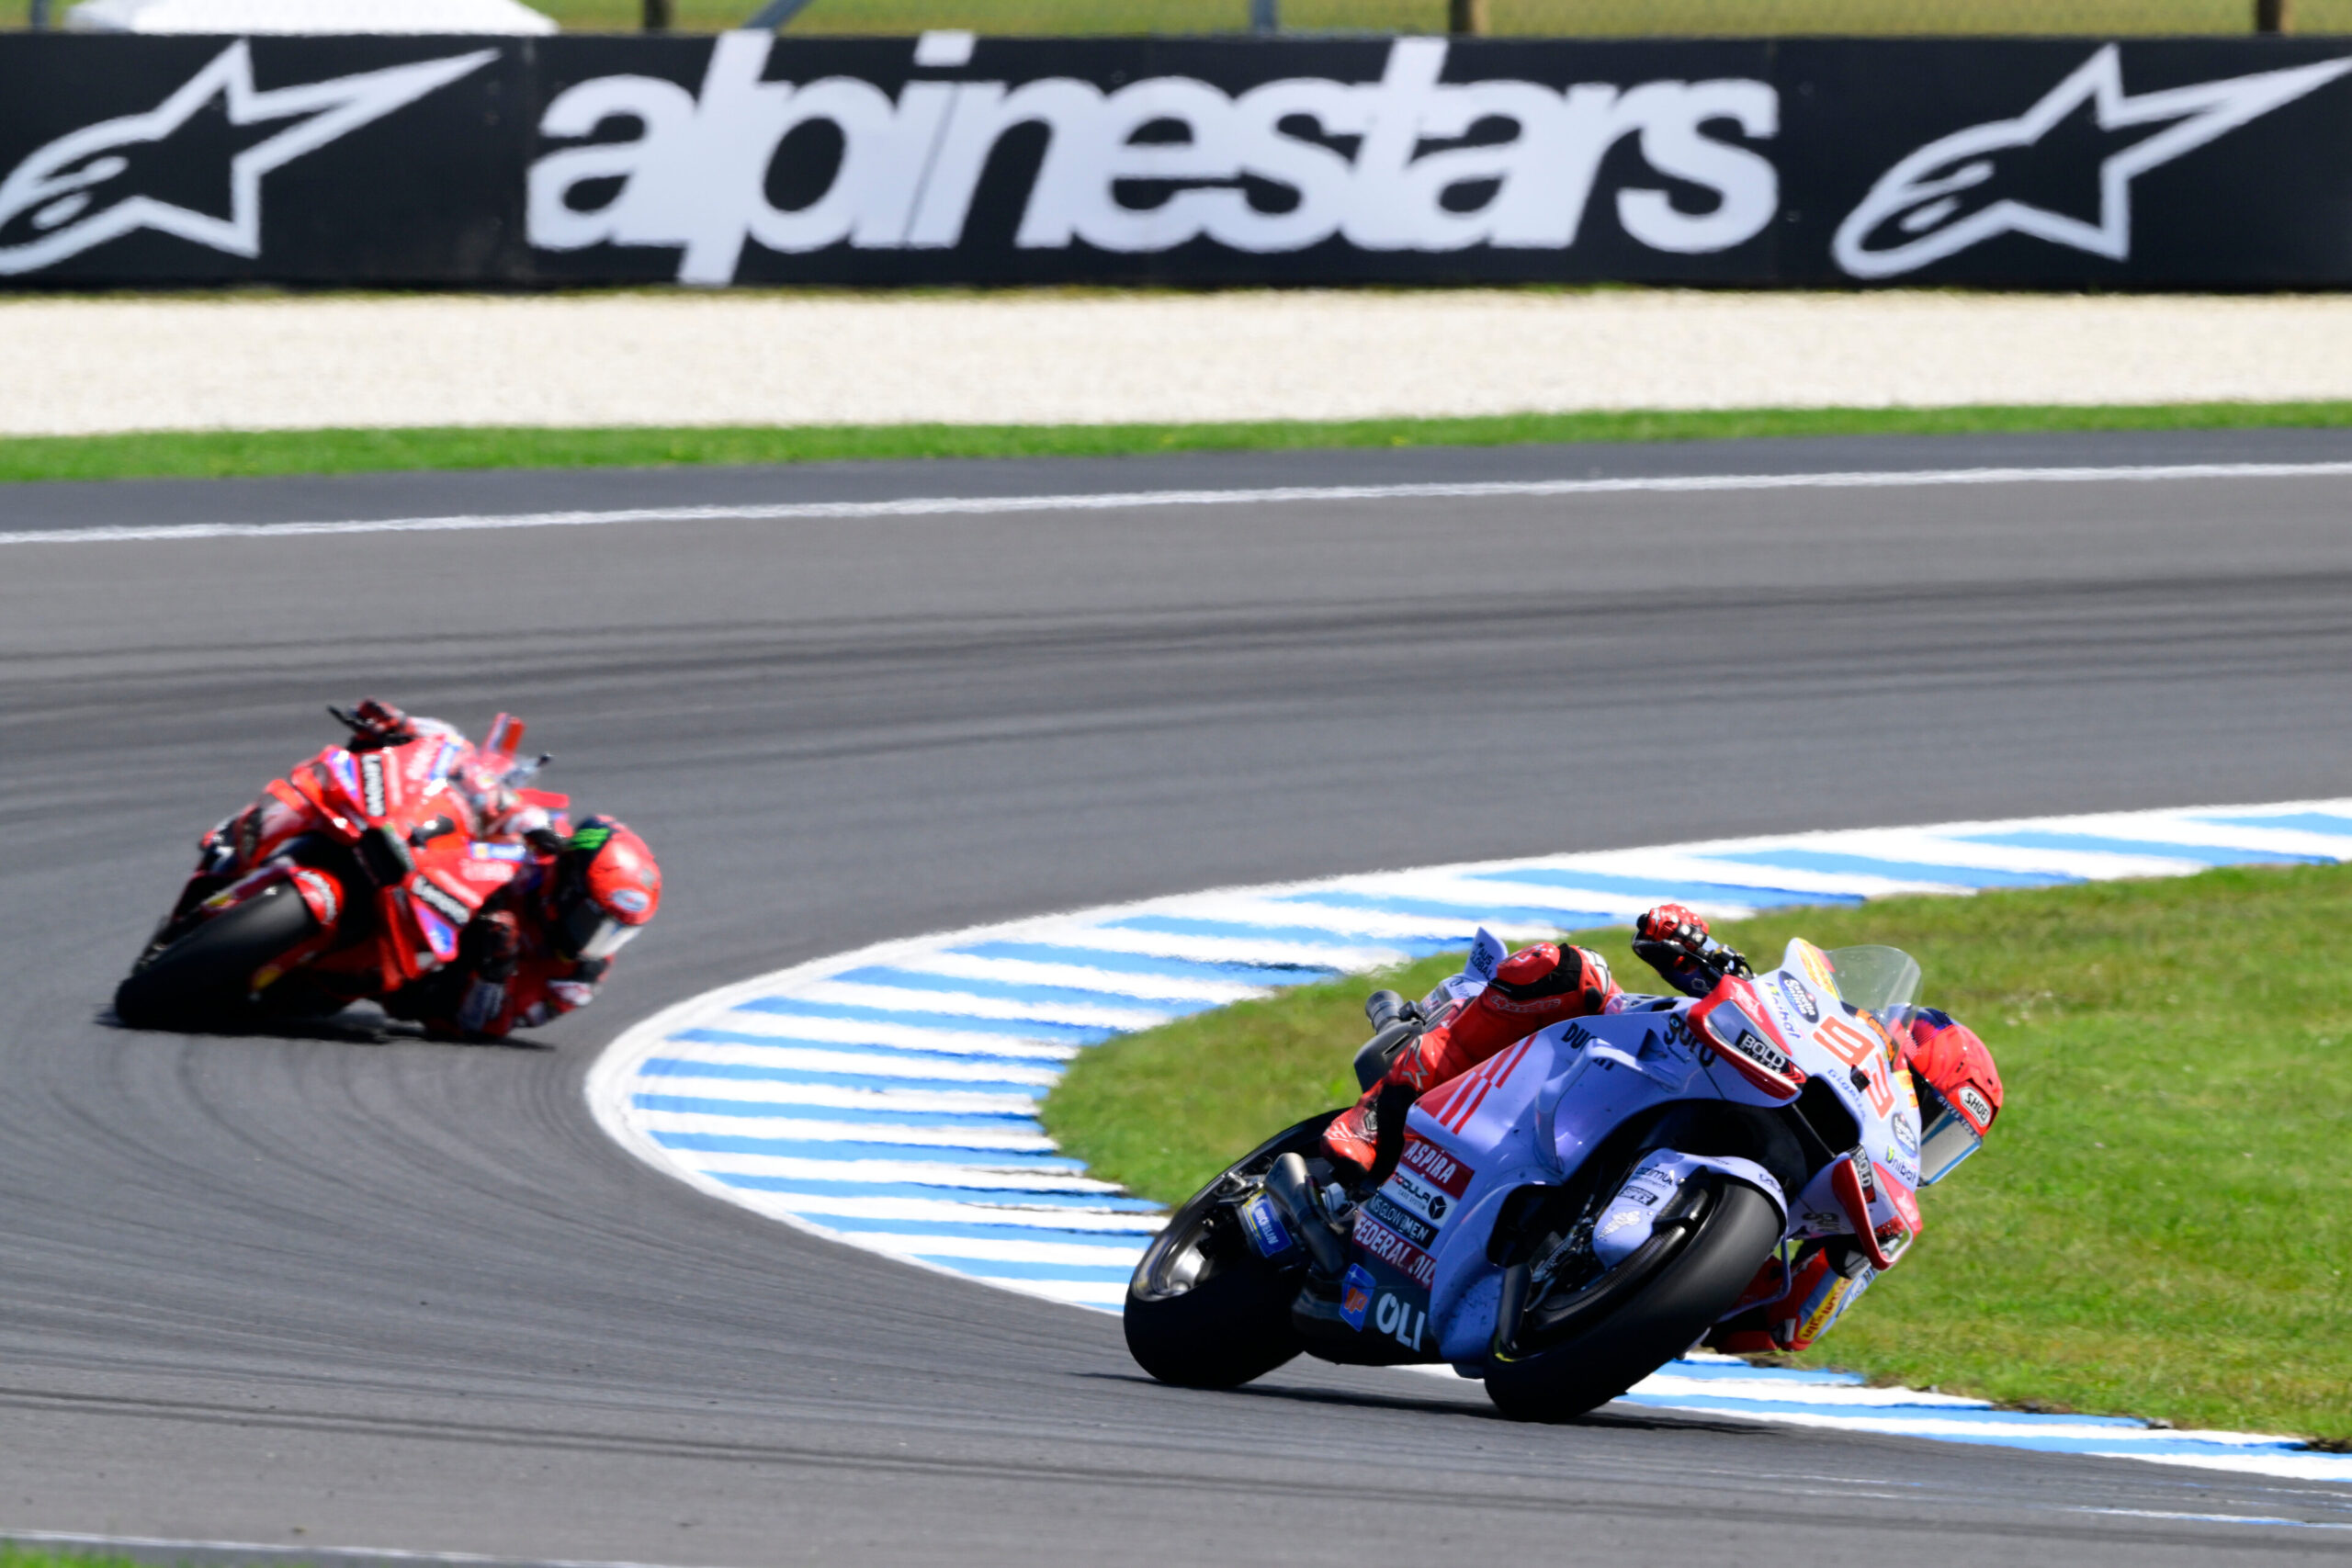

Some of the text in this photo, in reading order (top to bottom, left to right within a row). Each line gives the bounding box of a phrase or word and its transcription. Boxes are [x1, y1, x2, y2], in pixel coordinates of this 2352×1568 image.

[526, 29, 1780, 286] alpinestars
[1742, 1034, 1786, 1067] BOLD
[1813, 1016, 1895, 1119] 93
[1965, 1092, 1990, 1122] SHOEI
[1404, 1140, 1457, 1184] ASPIRA
[1856, 1147, 1872, 1188] BOLD
[1355, 1216, 1413, 1269] FEDERAL
